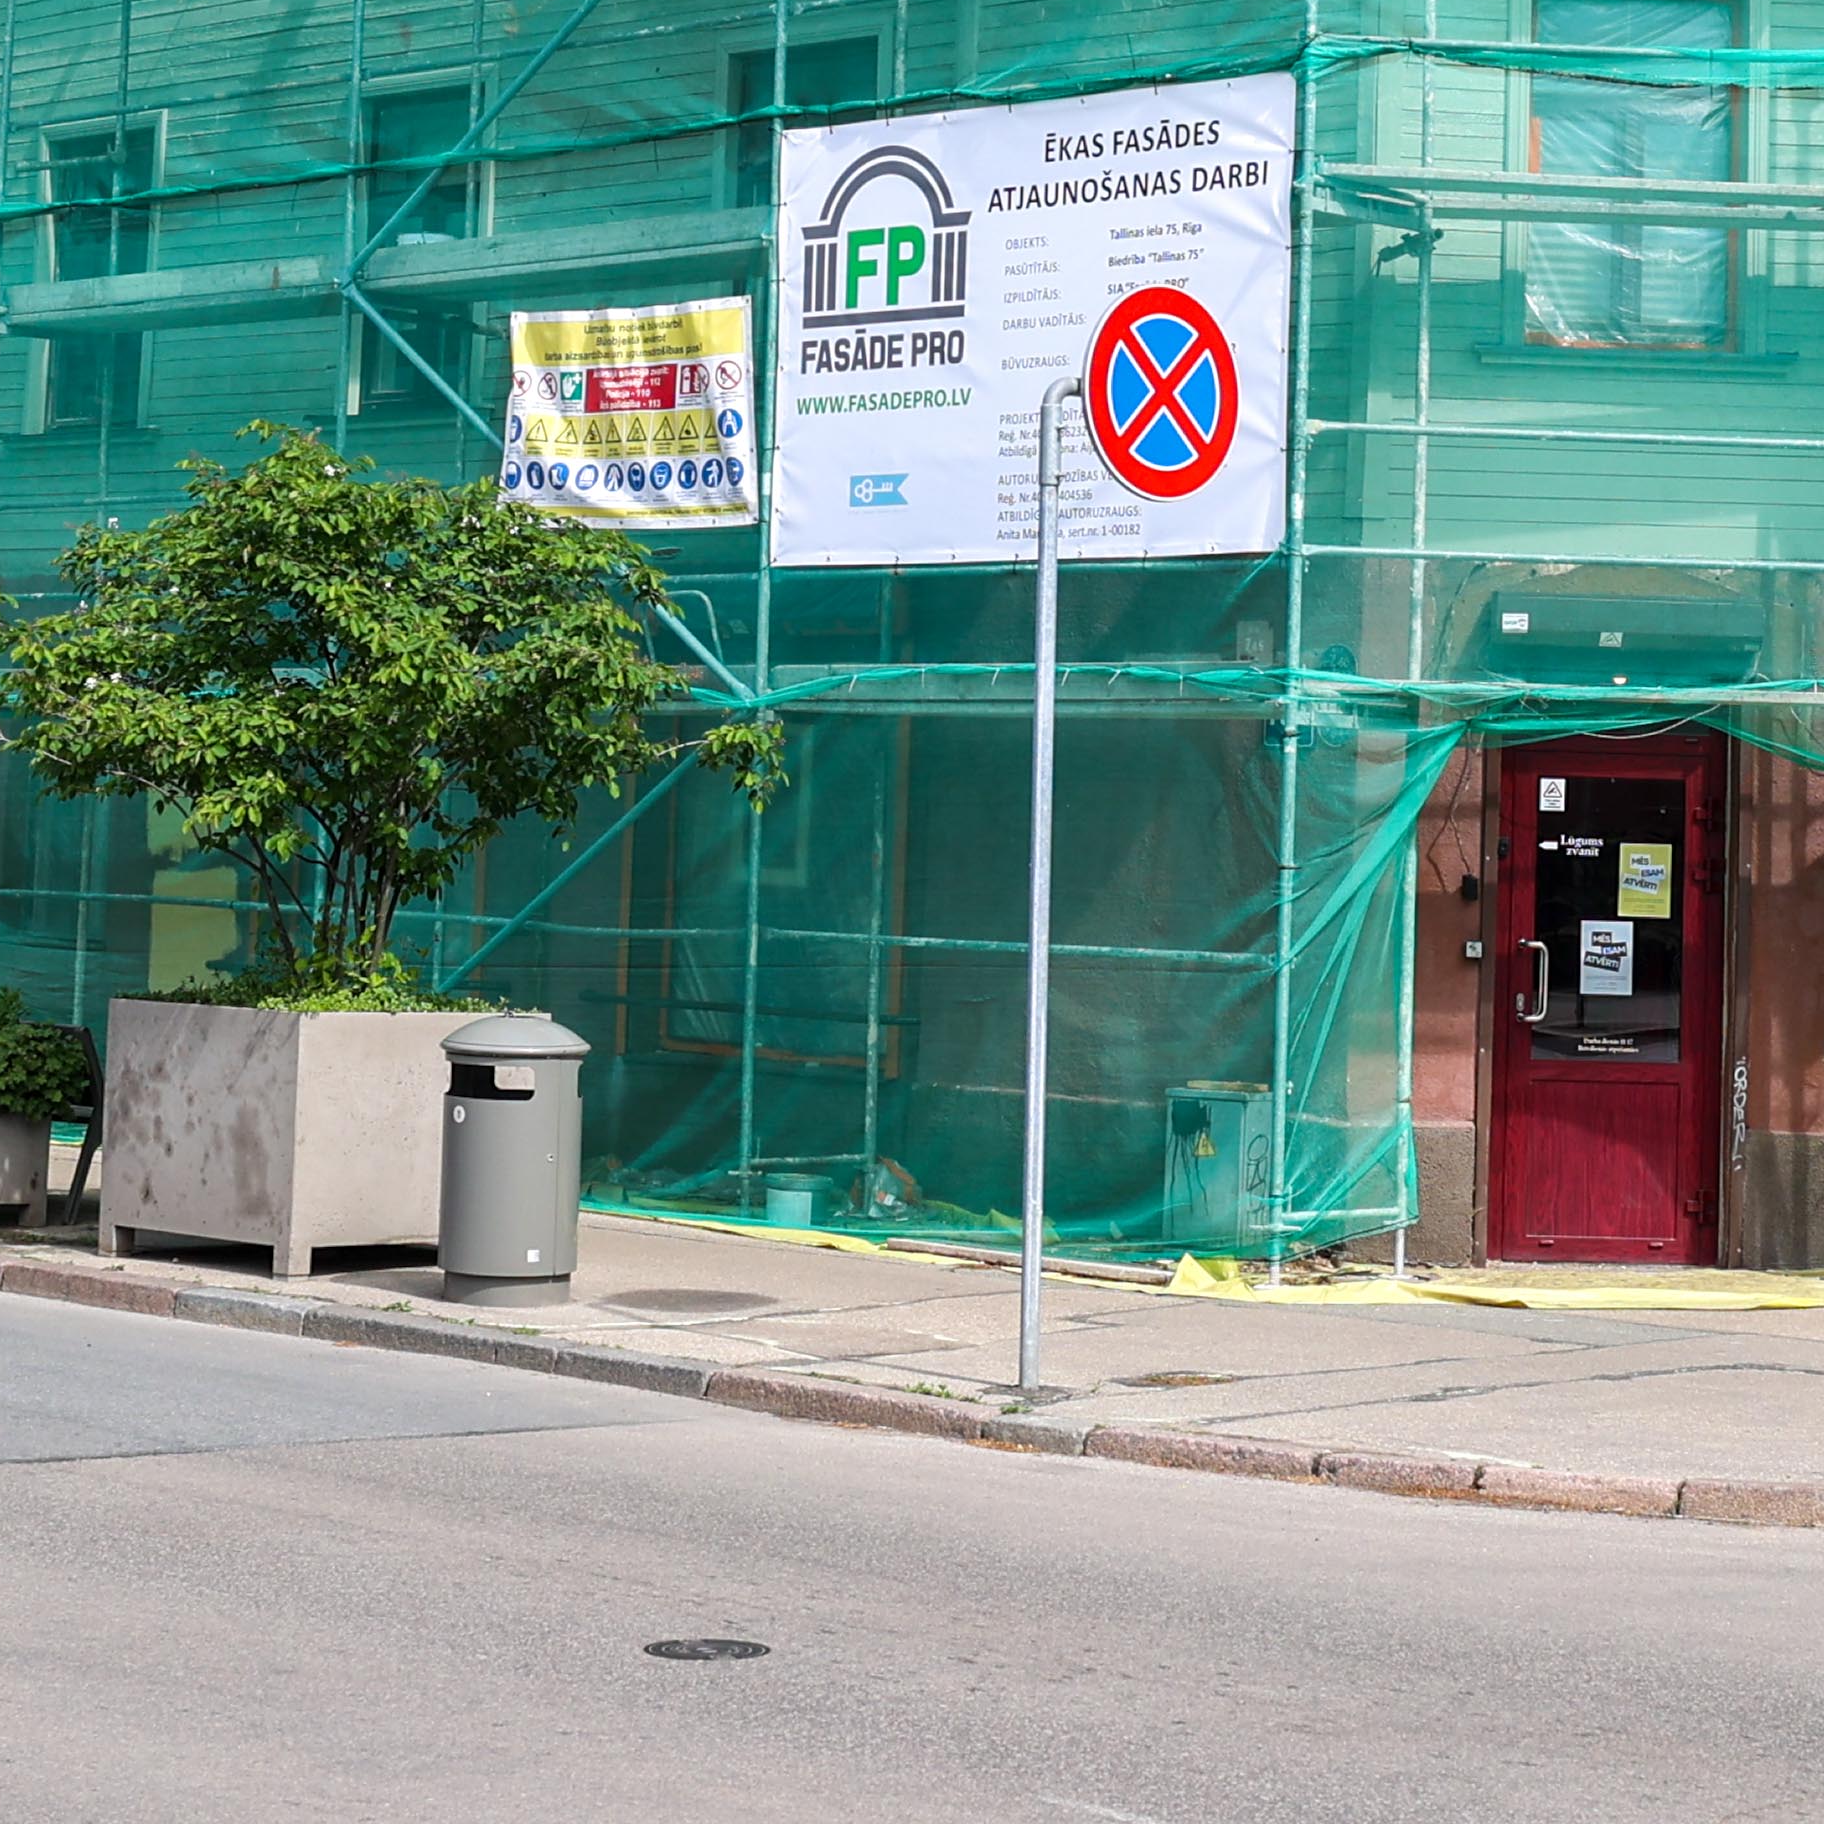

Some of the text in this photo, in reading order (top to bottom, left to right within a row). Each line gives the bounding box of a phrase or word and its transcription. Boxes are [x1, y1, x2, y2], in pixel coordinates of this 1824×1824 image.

[1044, 120, 1221, 163] ĒKAS FASĀDES
[988, 160, 1269, 213] ATJAUNOŠANAS DARBI
[1005, 237, 1049, 250] OBJEKTS:
[1109, 227, 1144, 240] Tallinas
[1146, 225, 1163, 237] iela
[845, 225, 926, 310] FP
[1002, 318, 1036, 330] DARBU
[801, 329, 965, 374] FASĀDE PRO
[797, 388, 972, 415] WWW.FASADEPRO.LV
[1560, 834, 1604, 849] Lūgums
